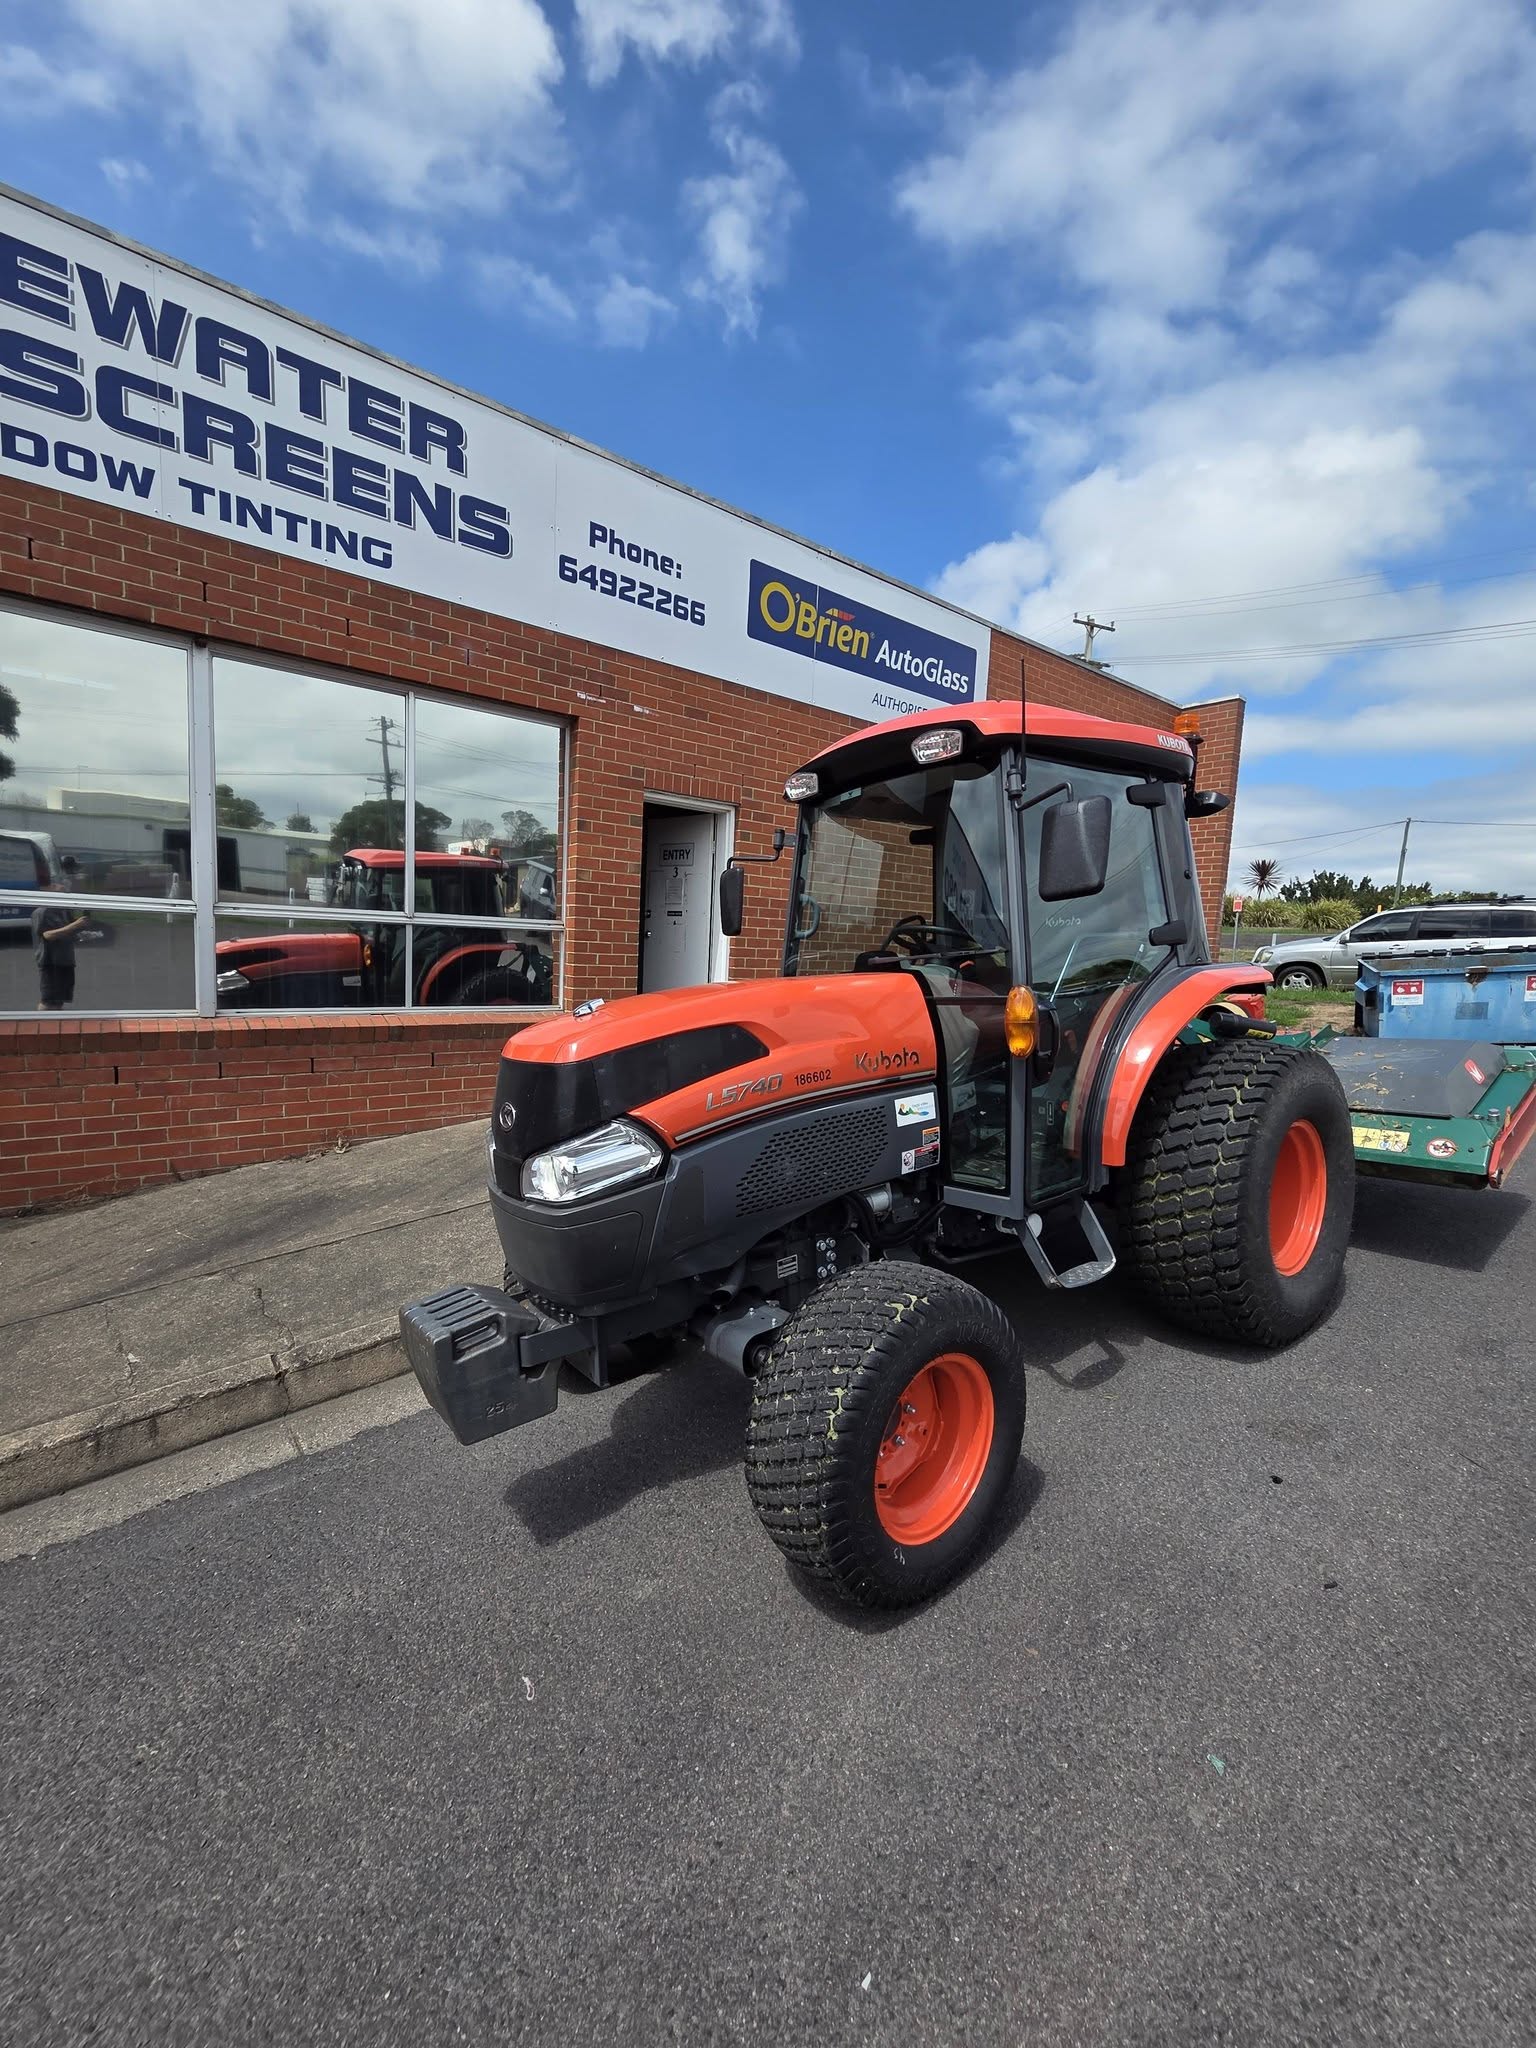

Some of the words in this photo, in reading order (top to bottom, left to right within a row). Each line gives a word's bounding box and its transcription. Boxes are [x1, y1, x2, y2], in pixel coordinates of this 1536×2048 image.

[0, 329, 512, 559] SCREENS
[1, 422, 155, 499] DOW
[178, 477, 393, 569] TINTING
[589, 521, 682, 579] Phone:
[559, 554, 706, 626] 64922266
[875, 639, 969, 694] AutoGlass
[872, 692, 928, 715] AUTHORIS
[663, 848, 691, 860] ENTRY
[673, 867, 679, 878] 3
[854, 1047, 920, 1073] Kubota
[706, 1073, 783, 1111] L5740
[794, 1069, 832, 1086] 186602
